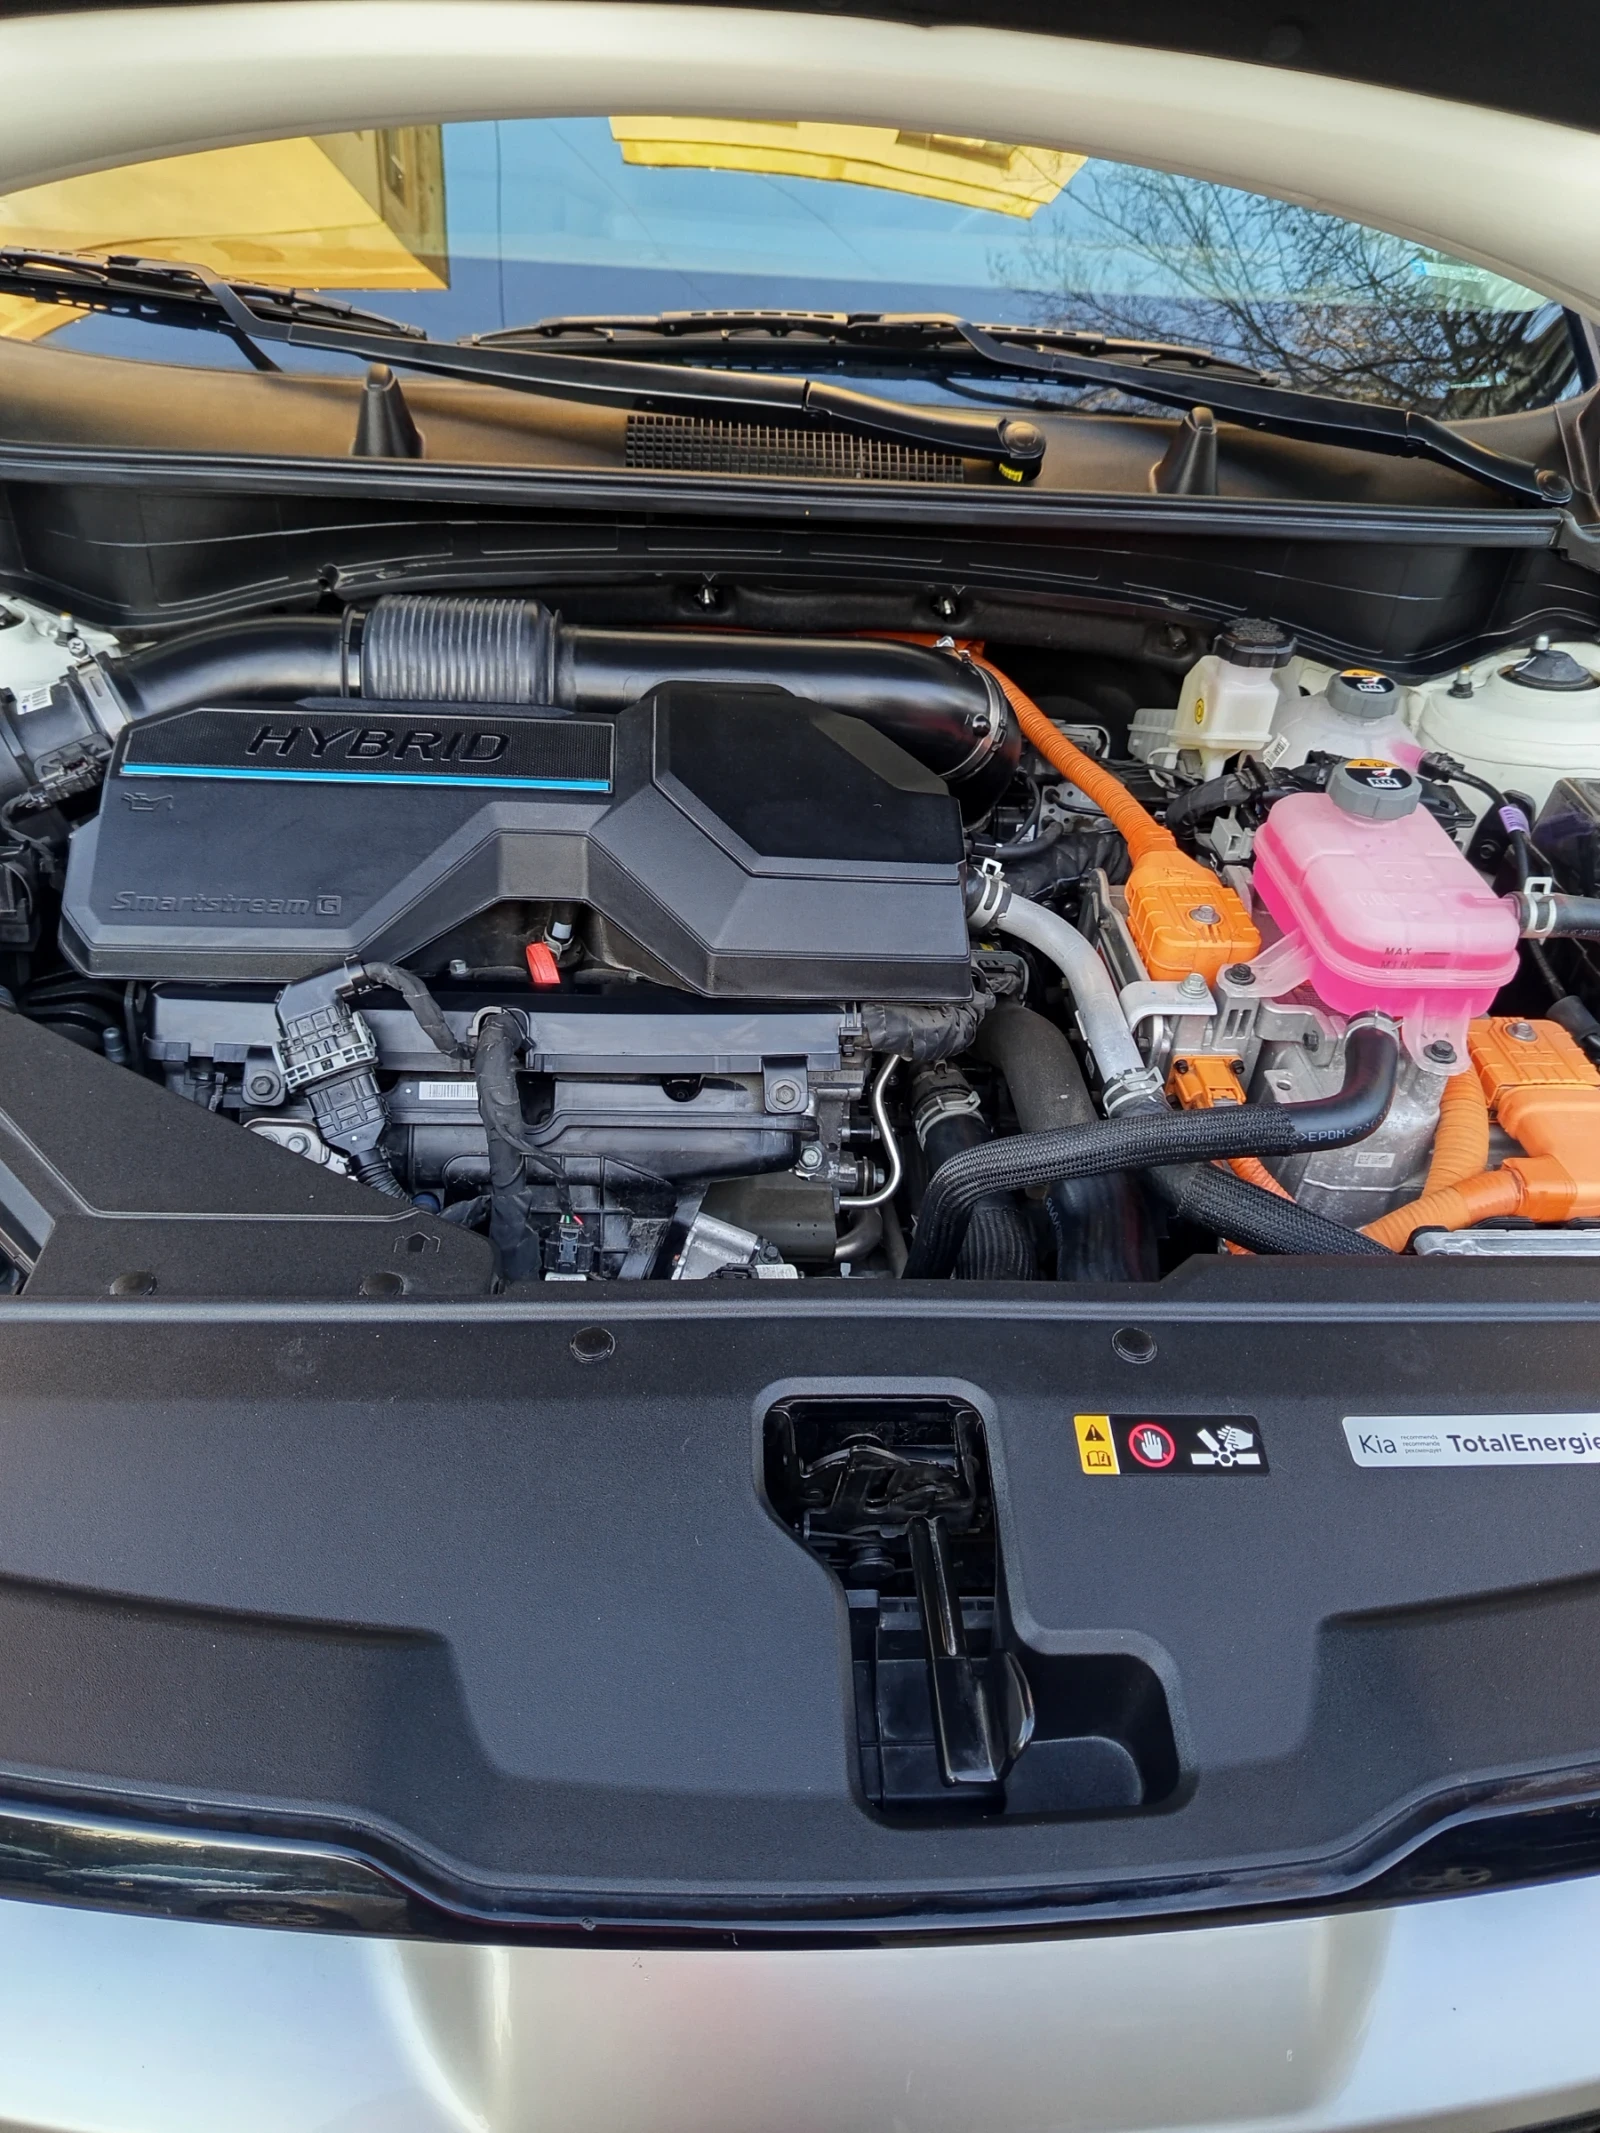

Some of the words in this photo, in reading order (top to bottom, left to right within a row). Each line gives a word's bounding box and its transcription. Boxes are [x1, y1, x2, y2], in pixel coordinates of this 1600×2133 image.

[245, 724, 511, 762] HYBRID
[110, 891, 310, 915] Smartstream
[316, 895, 342, 916] G
[1384, 947, 1412, 956] MAX
[1358, 1433, 1398, 1454] Kia
